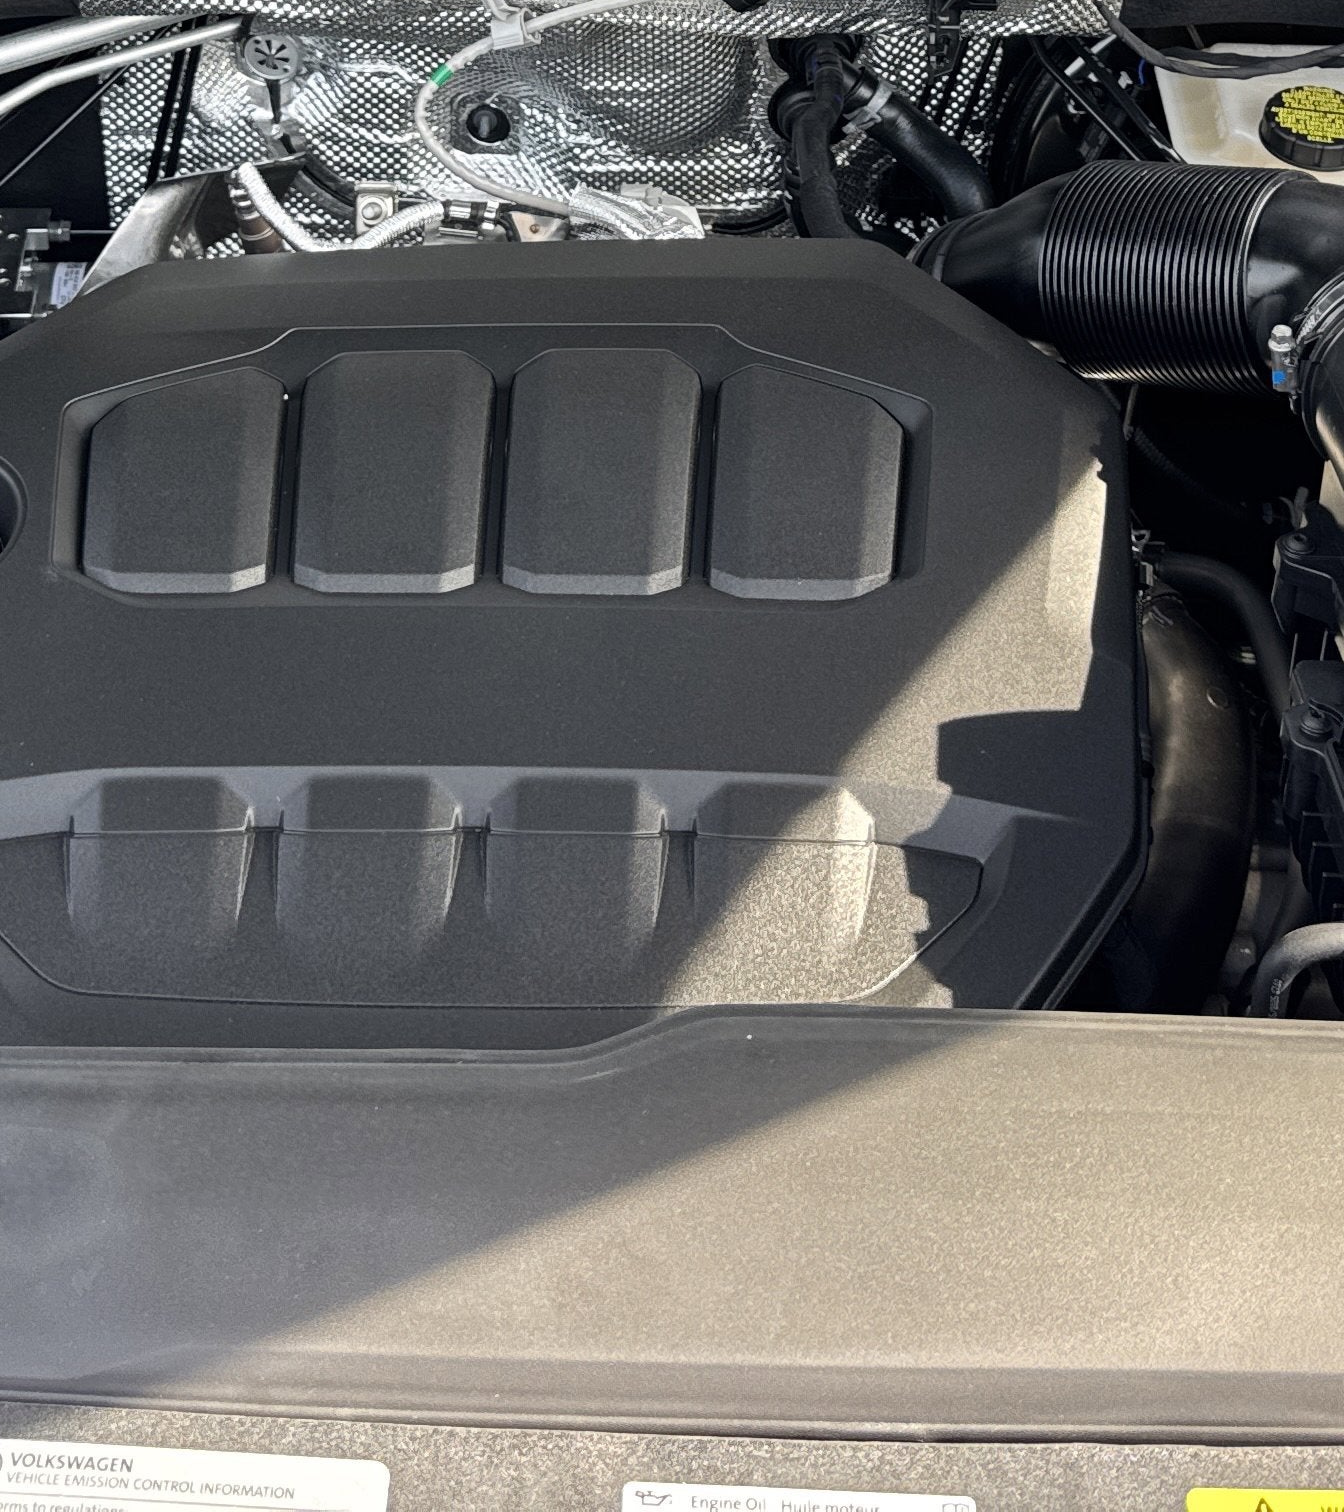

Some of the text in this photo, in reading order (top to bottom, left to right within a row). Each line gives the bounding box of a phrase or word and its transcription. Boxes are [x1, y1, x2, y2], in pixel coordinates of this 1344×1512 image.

[10, 1452, 134, 1473] VOLKSWAGEN
[7, 1471, 296, 1500] VEHICLE EMISSION CONTROL INFORMATION
[32, 1500, 46, 1512] to
[691, 1495, 741, 1512] Engine
[746, 1497, 767, 1512] Oil
[781, 1498, 821, 1512] Huile
